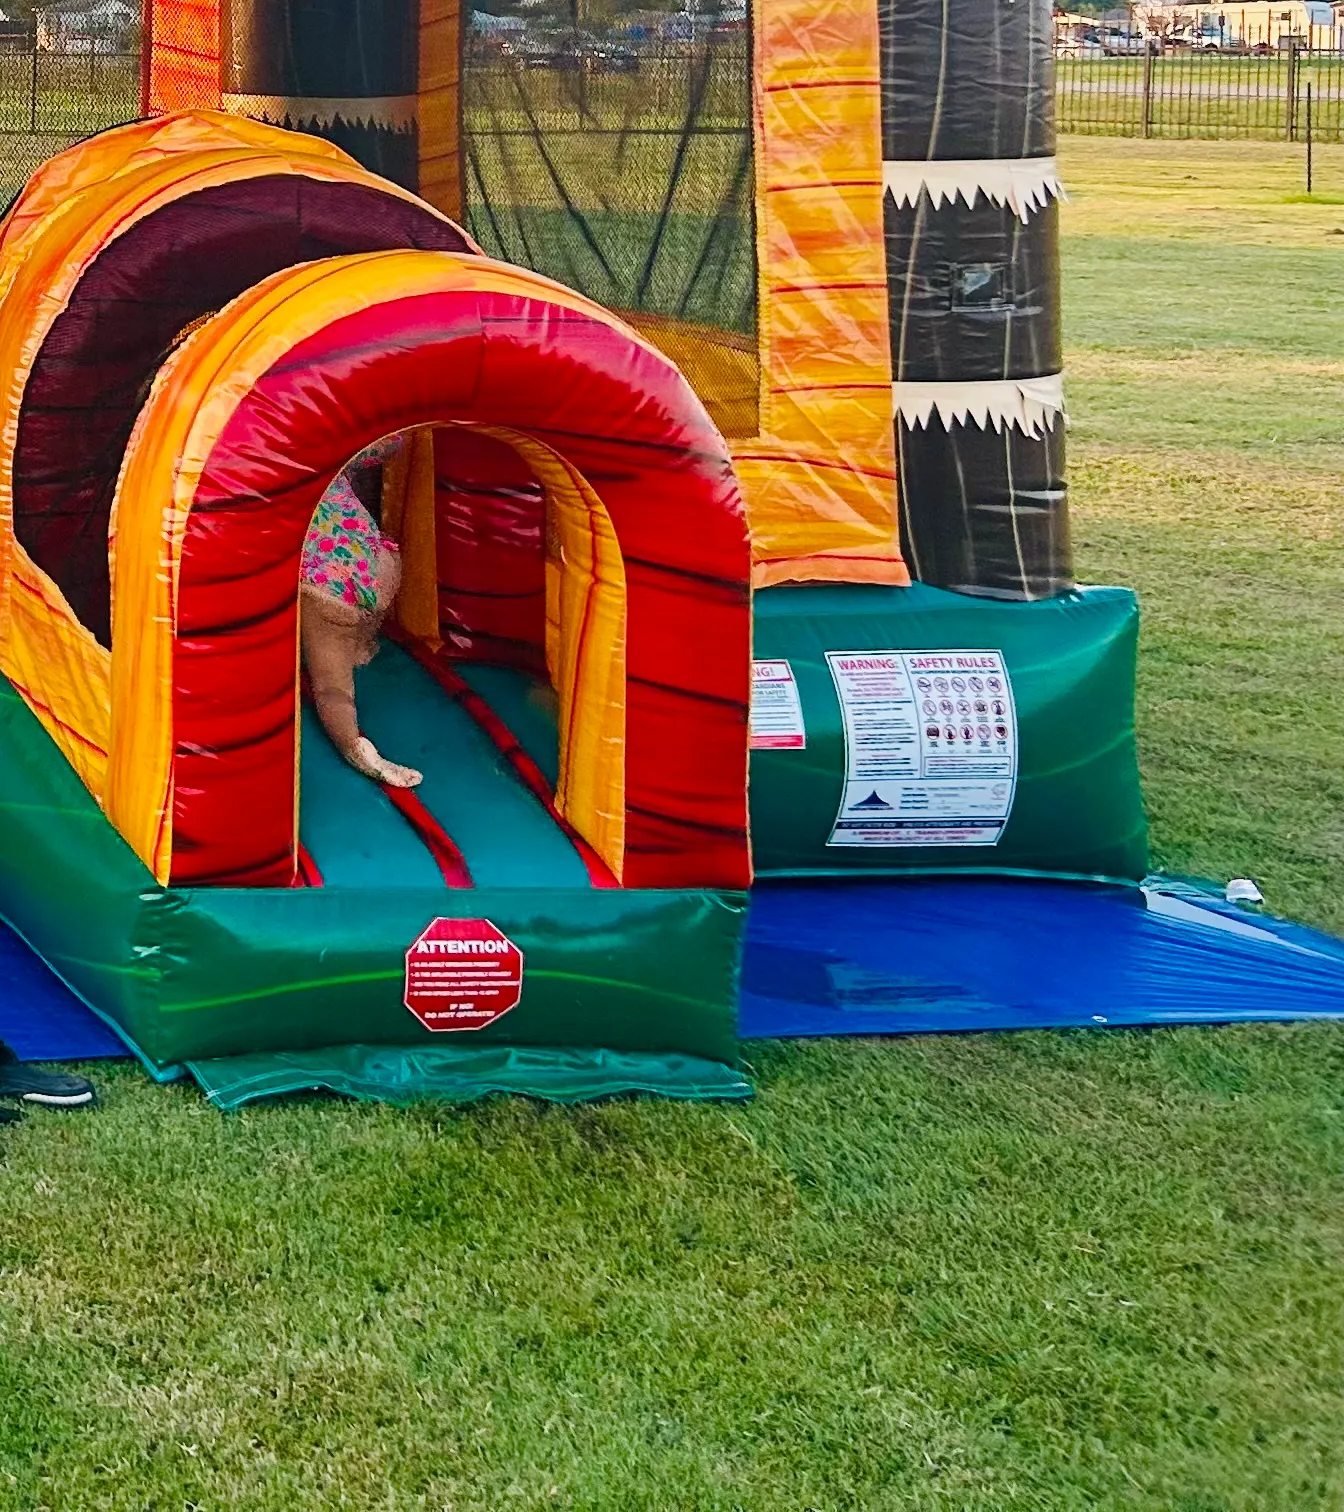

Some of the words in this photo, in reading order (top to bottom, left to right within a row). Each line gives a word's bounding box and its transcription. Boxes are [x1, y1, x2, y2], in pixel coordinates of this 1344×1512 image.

[910, 657, 953, 669] SAFETY
[956, 656, 996, 668] RULES
[417, 940, 509, 954] ATTENTION
